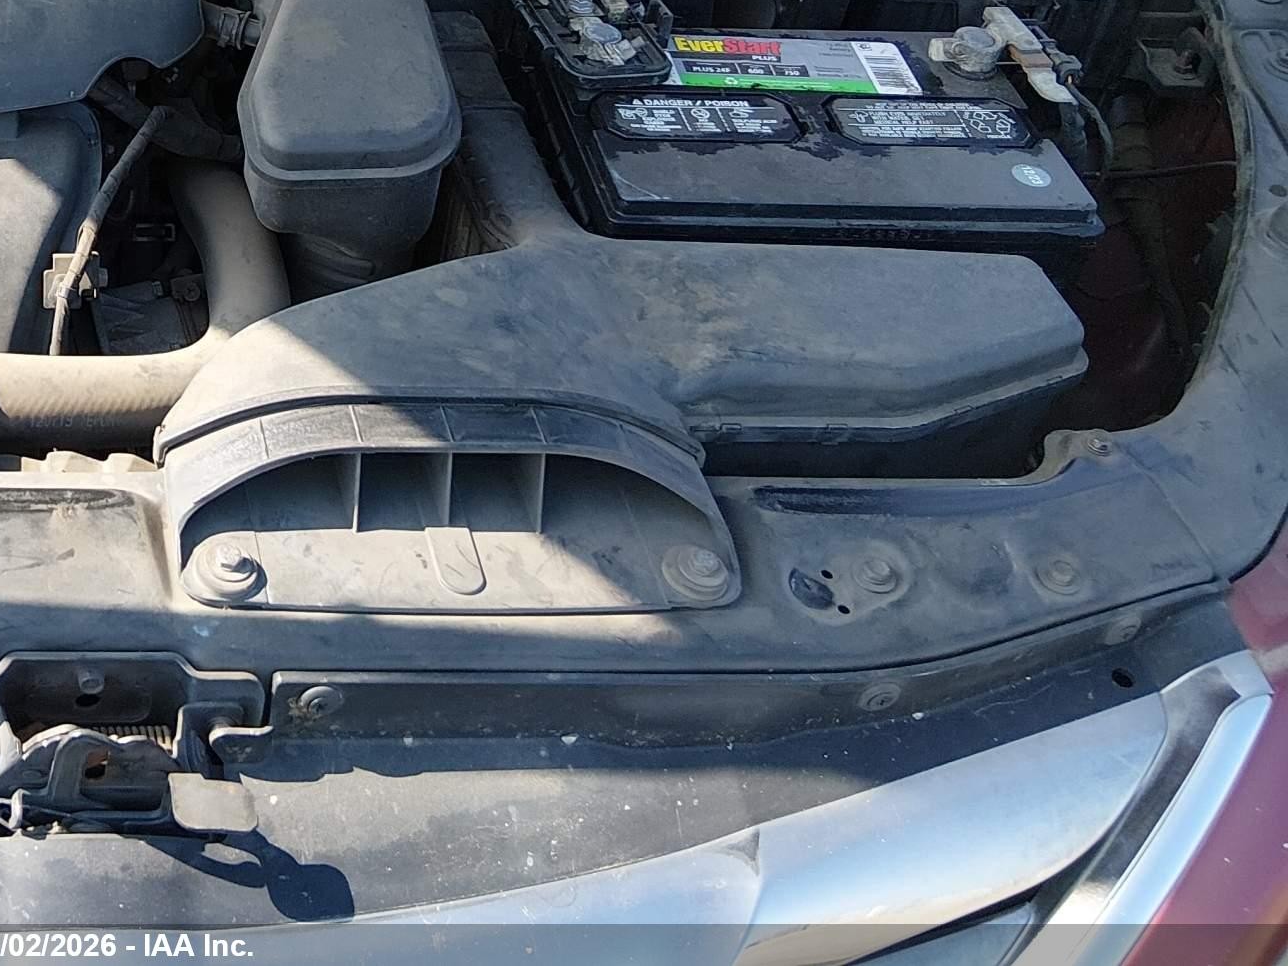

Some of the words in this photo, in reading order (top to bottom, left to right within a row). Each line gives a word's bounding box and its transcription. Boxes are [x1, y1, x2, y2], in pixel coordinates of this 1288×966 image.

[673, 36, 781, 55] EverStart
[643, 98, 693, 107] DANGER
[703, 99, 749, 108] POISON
